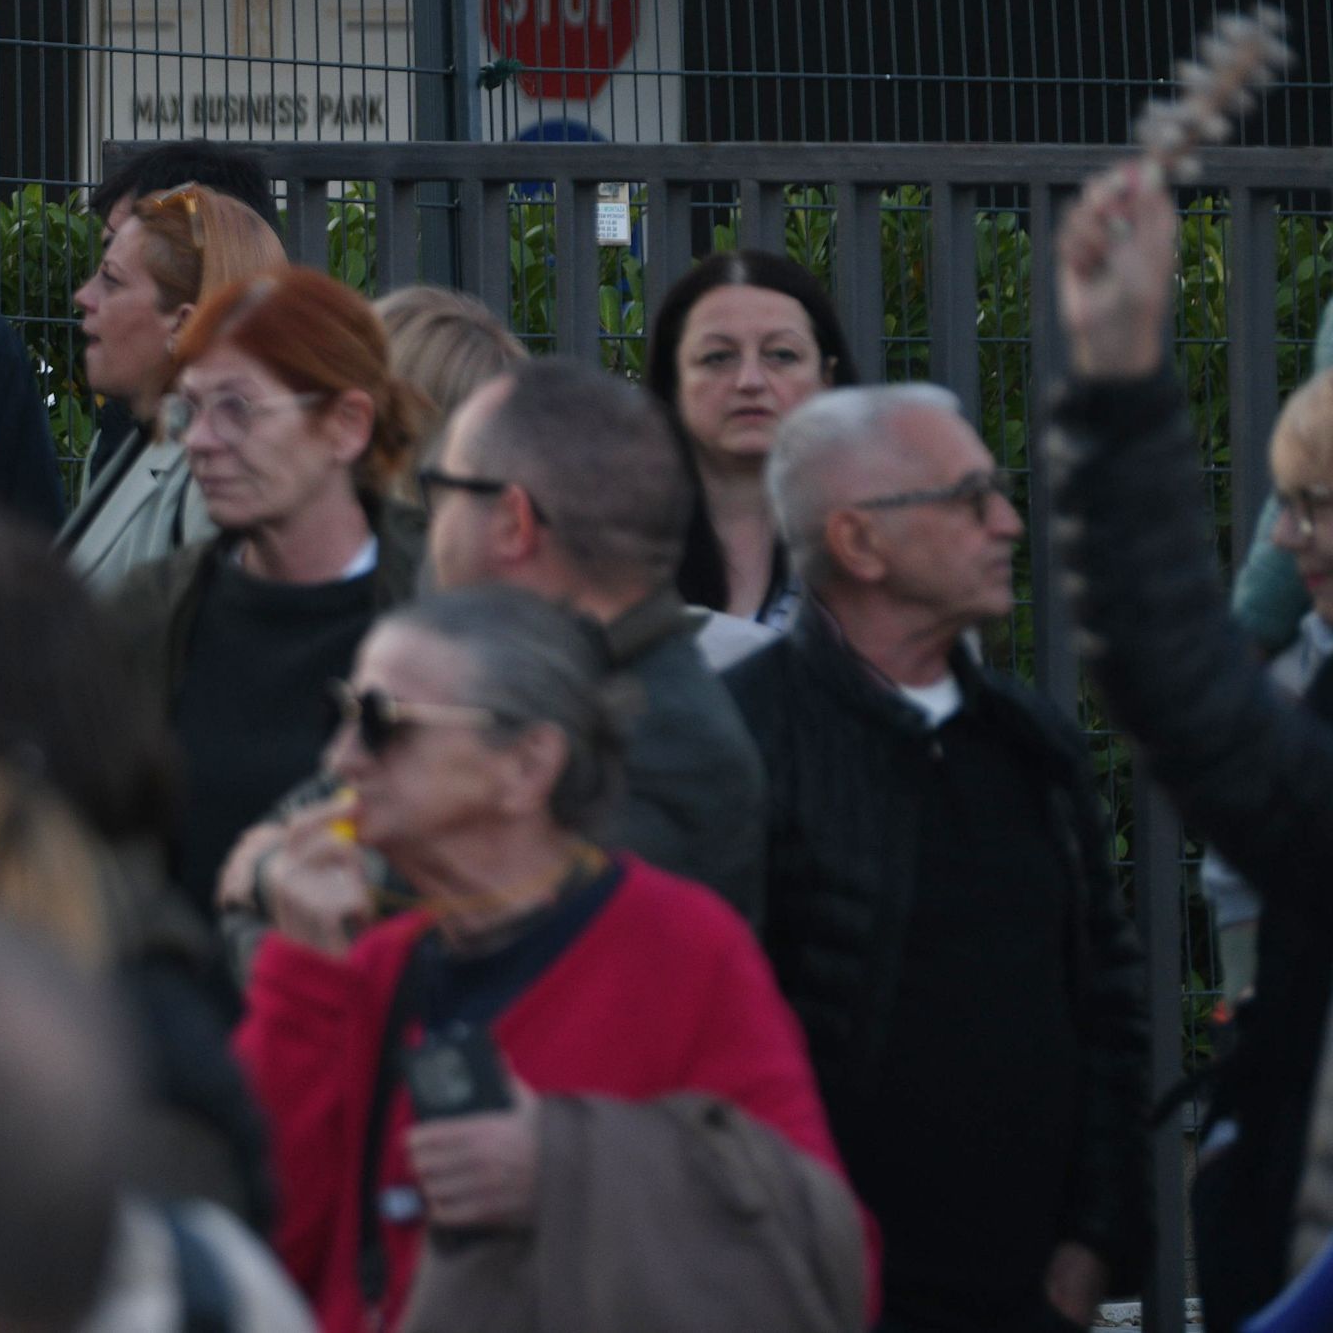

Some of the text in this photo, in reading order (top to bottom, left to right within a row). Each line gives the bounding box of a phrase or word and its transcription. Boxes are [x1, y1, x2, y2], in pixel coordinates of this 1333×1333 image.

[134, 93, 384, 127] MAX BUSINESS PARK
